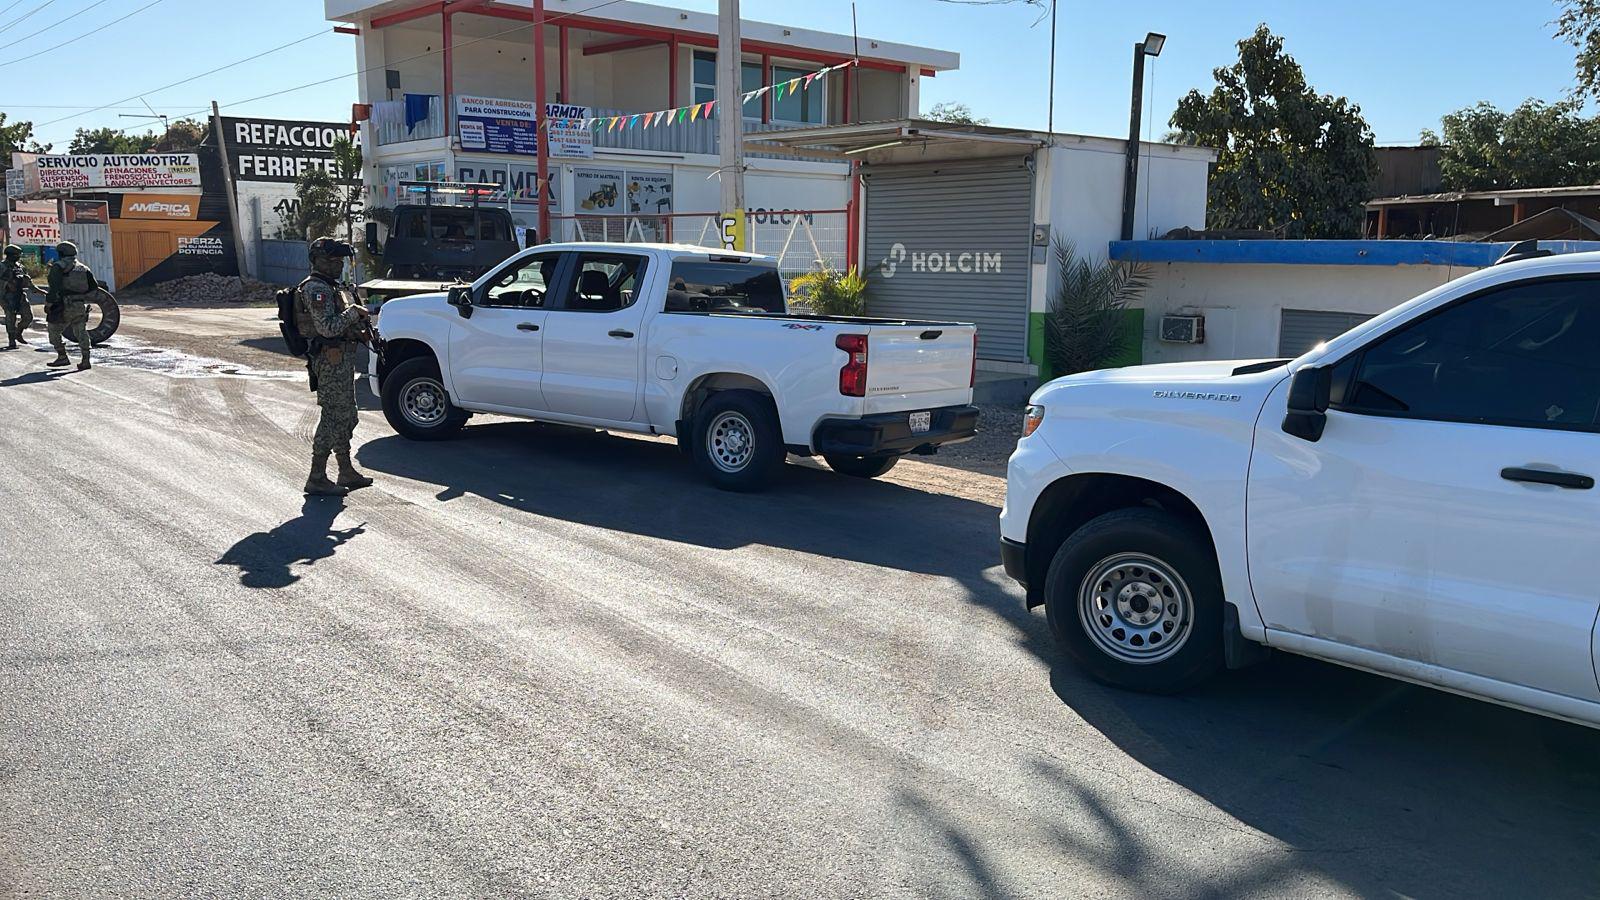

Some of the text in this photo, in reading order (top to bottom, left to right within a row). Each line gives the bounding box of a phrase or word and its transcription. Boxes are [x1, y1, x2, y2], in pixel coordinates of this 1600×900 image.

[483, 108, 531, 117] CONSTRUCCIÓN
[546, 105, 585, 119] ARMOK
[38, 156, 190, 168] SERVICIO AUTOMOTRIZ
[129, 202, 191, 212] AMÉRICA
[11, 215, 37, 223] CAMBIO
[911, 252, 1002, 273] HOLCIM
[1153, 391, 1241, 402] SILVERADO
